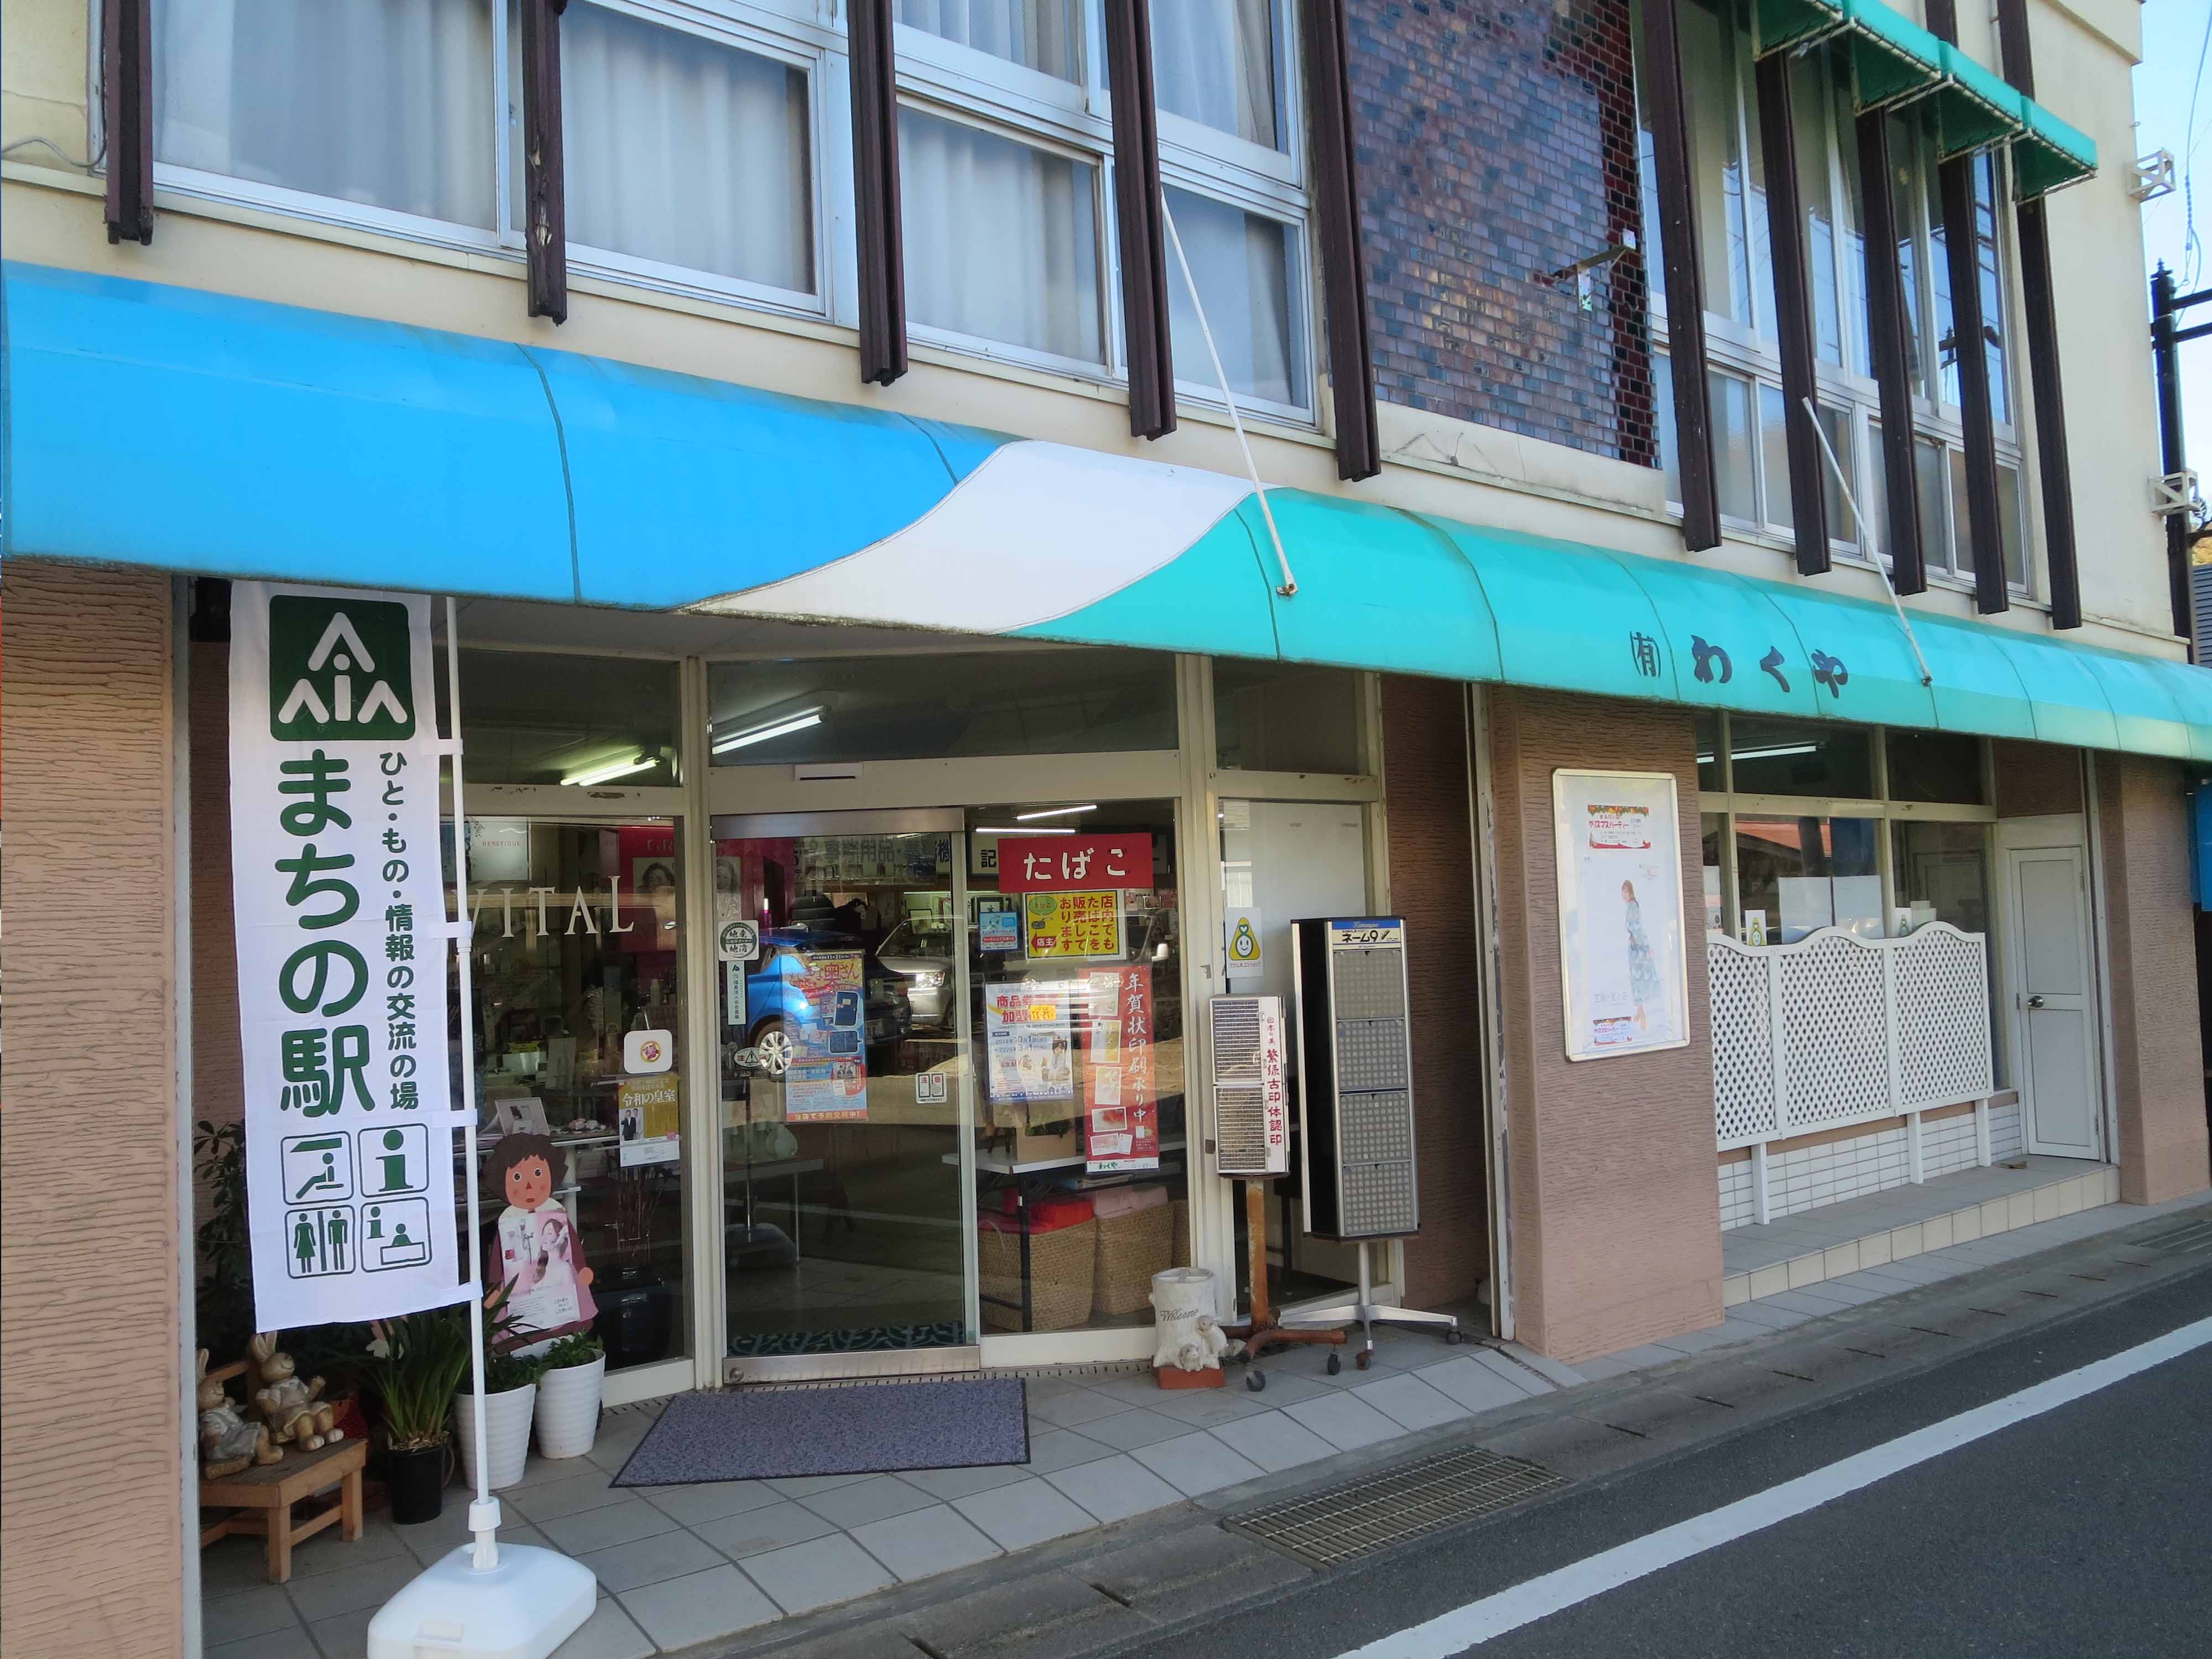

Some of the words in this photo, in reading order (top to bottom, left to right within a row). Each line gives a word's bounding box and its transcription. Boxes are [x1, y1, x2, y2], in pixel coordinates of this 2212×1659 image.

[1691, 634, 1849, 699] わくや
[1023, 847, 1126, 881] たばこ
[275, 749, 375, 1117] まちの駅
[379, 752, 419, 1110] ひと・もの・情報の交流の場
[1060, 898, 1073, 952] おります
[1073, 896, 1087, 951] 販売して
[1087, 896, 1100, 950] たばこを
[1342, 930, 1379, 943] ネーム9
[1124, 973, 1147, 1124] 年賀状印刷承り中
[623, 1088, 676, 1107] 令和の皇室
[1159, 1308, 1198, 1322] Welcome
